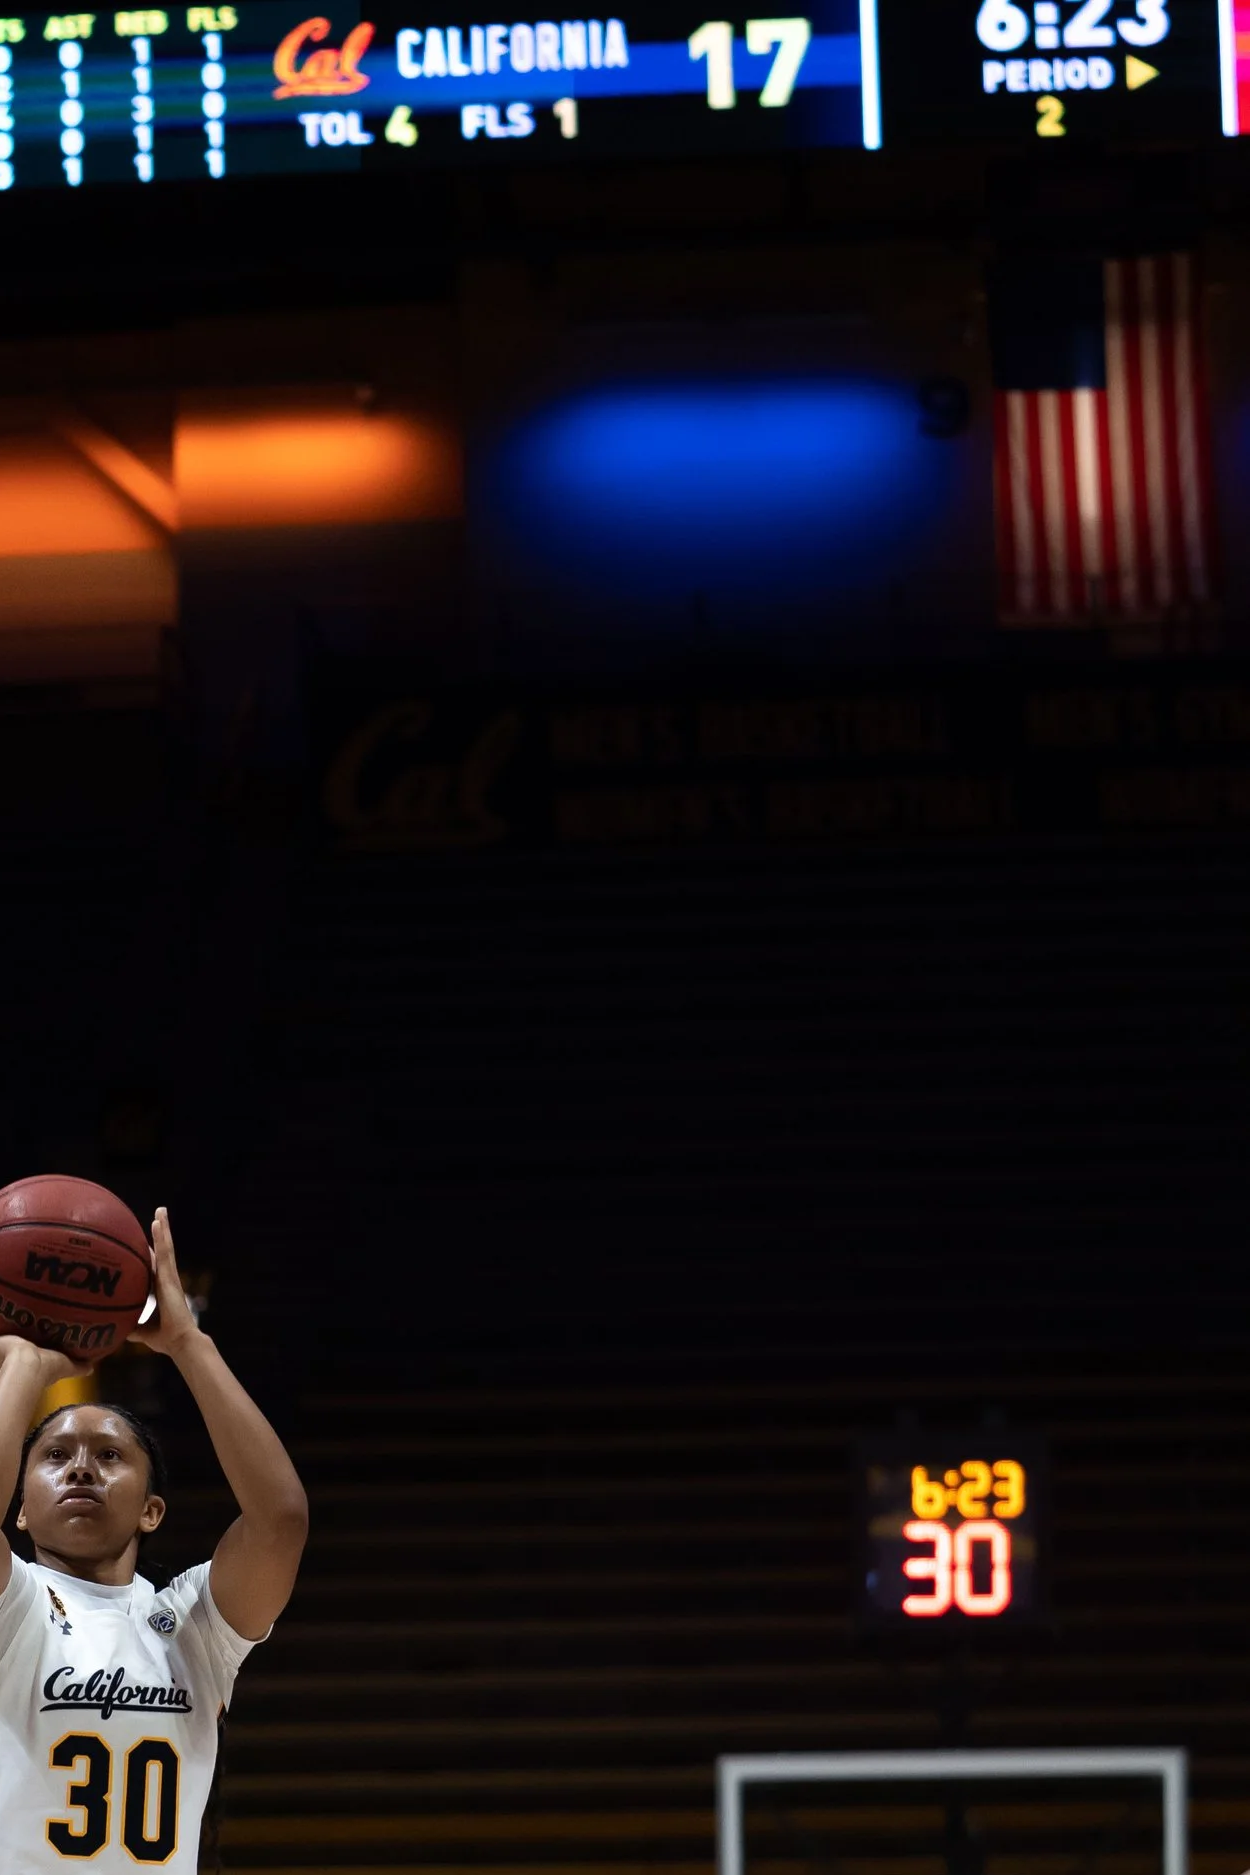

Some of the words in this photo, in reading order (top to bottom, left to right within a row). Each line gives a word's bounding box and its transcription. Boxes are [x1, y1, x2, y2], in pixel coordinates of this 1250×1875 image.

[43, 14, 95, 41] AST
[186, 6, 238, 32] FLS
[131, 37, 150, 65] 1
[202, 33, 221, 61] 1
[273, 17, 376, 100] Cal
[395, 20, 630, 80] CALIFORNIA
[687, 17, 812, 110] 17
[61, 70, 80, 98] 1
[132, 66, 151, 94] 1
[982, 56, 1115, 94] PERIOD
[133, 124, 152, 152] 1
[204, 120, 223, 148] 1
[298, 111, 372, 147] TOL
[385, 104, 418, 147] 4
[461, 102, 534, 139] FLS
[553, 97, 576, 138] 1
[1036, 94, 1066, 137] 2
[62, 157, 82, 186] 1
[134, 153, 153, 182] 1
[205, 149, 225, 178] 1
[319, 698, 525, 851] Cal
[26, 1253, 121, 1296] NCAA
[911, 1459, 1026, 1519] 6:23
[902, 1519, 1012, 1617] 30
[40, 1666, 193, 1720] California
[45, 1730, 181, 1866] 30
